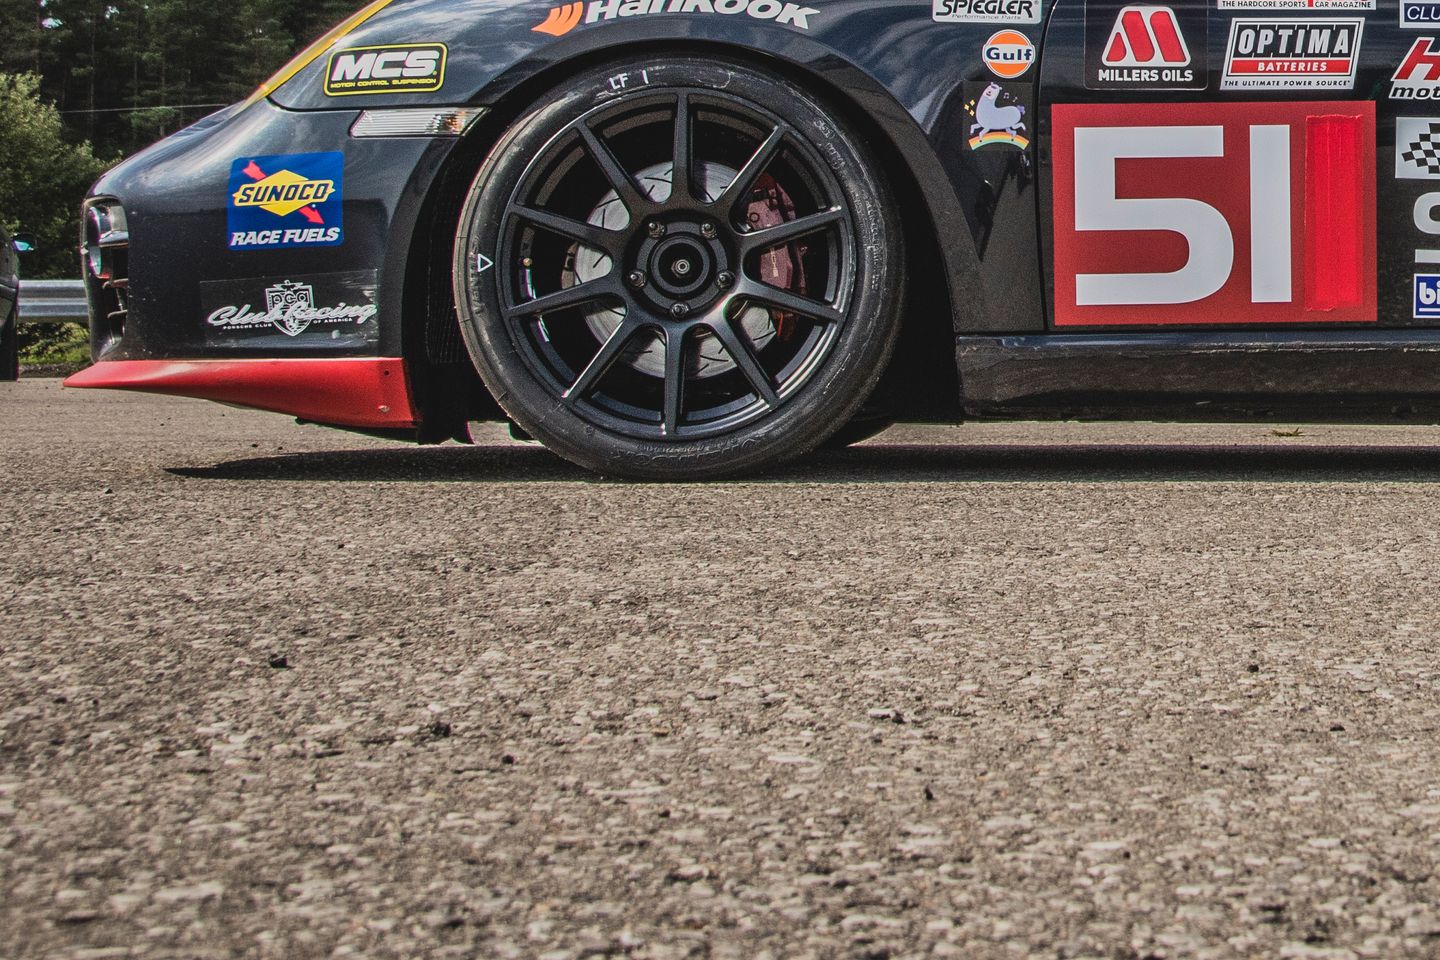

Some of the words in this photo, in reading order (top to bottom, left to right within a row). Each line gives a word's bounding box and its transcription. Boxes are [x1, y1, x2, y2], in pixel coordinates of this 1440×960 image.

[1238, 28, 1349, 55] OPTIMA
[985, 47, 1033, 61] Gulf
[331, 50, 440, 81] MCS
[1257, 61, 1328, 72] BATTERIES
[1098, 69, 1159, 82] MILLERS
[1161, 69, 1194, 82] OILS
[238, 183, 330, 203] SUNOCO
[1074, 124, 1292, 306] 51
[230, 229, 283, 246] RACE
[282, 227, 341, 243] FUELS
